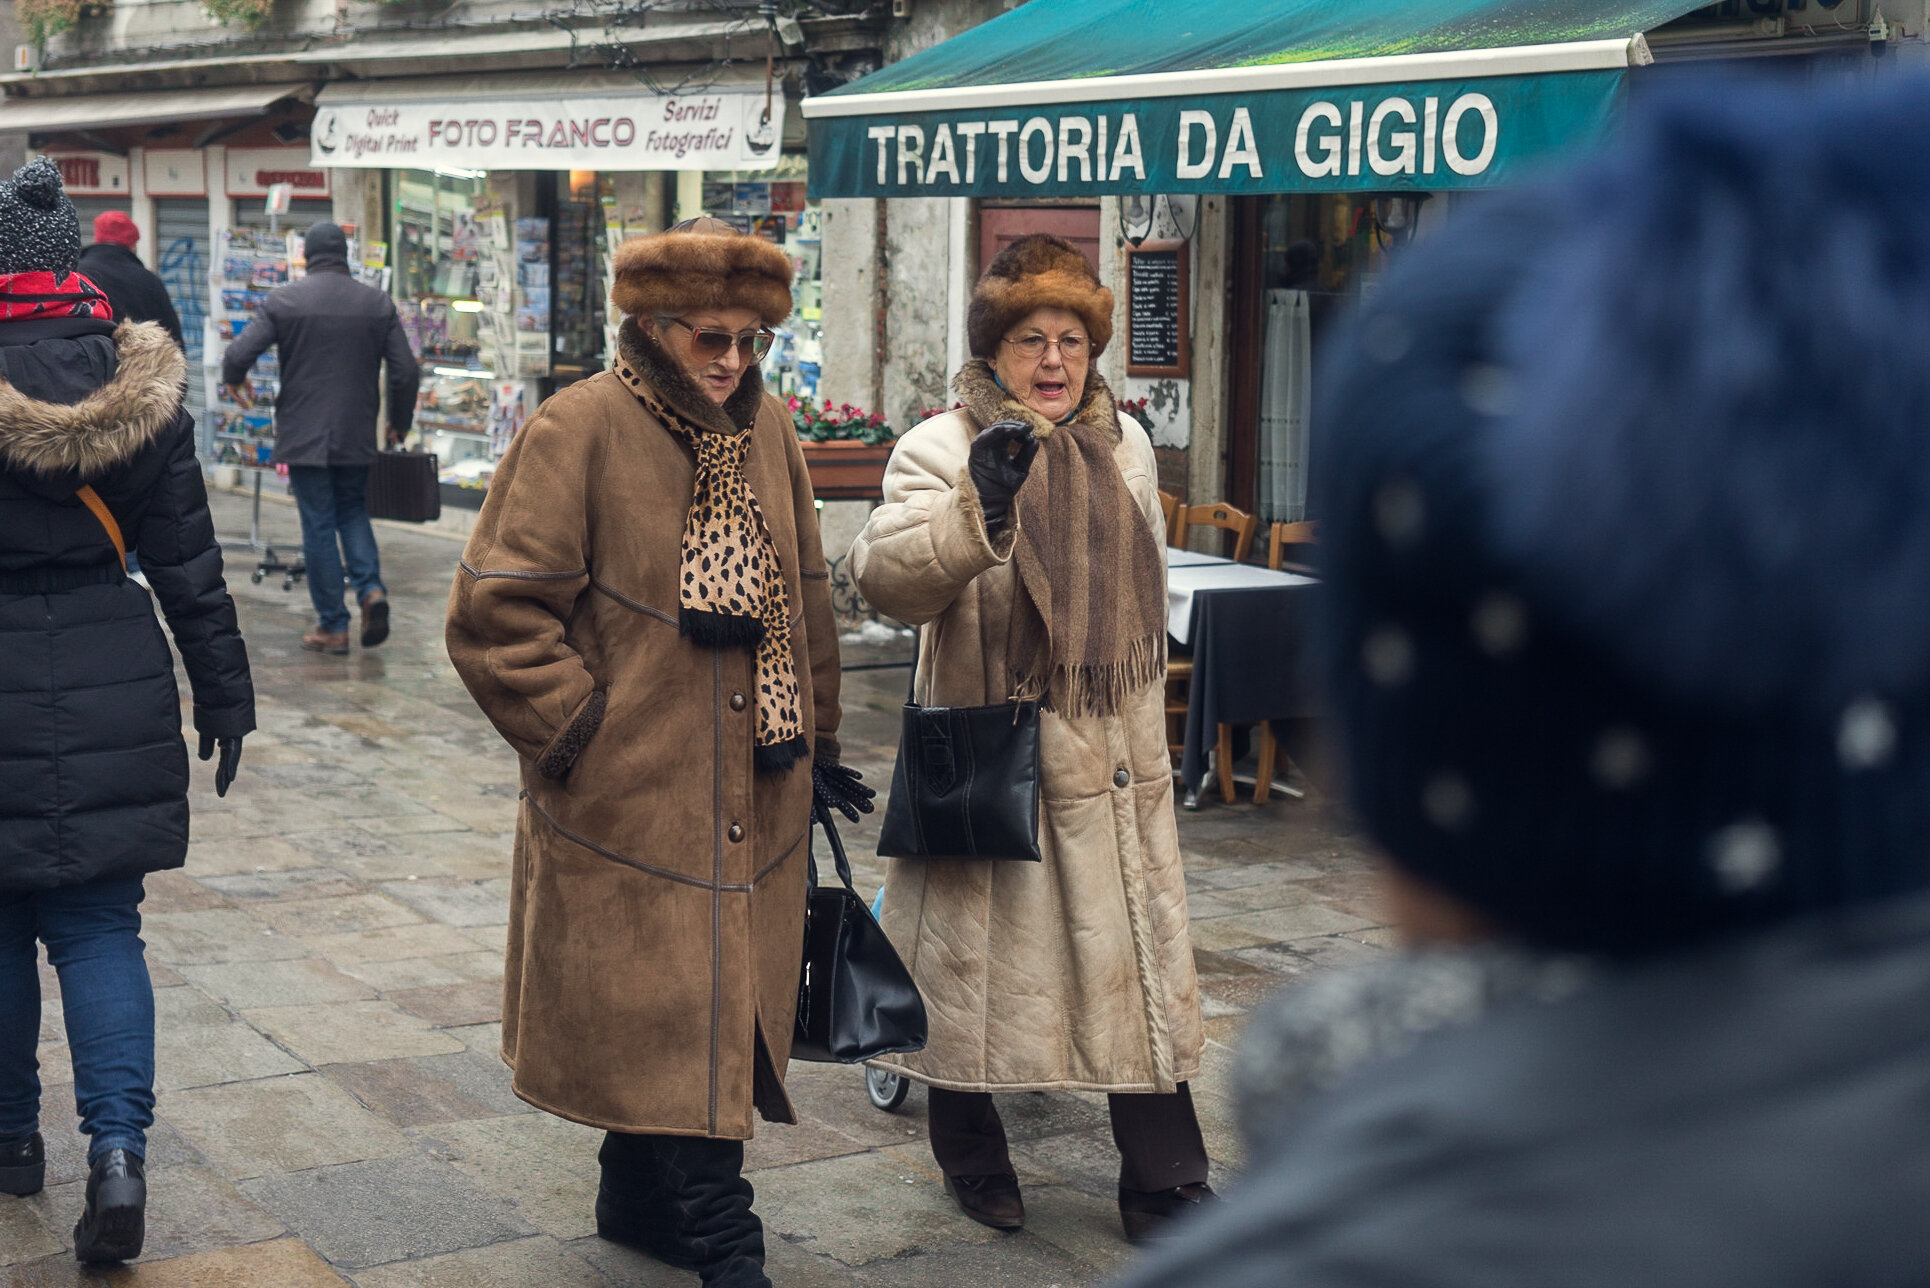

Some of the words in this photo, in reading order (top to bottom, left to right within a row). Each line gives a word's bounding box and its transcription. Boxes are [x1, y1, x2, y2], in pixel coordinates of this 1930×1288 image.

[367, 106, 399, 128] Quick
[663, 97, 722, 123] Servizi
[345, 134, 383, 159] Digital
[385, 135, 419, 152] Print
[428, 119, 497, 148] FOTO
[504, 117, 636, 148] FRANCO
[644, 127, 734, 159] Fotografici
[867, 113, 1146, 186] TRATTORIA
[1176, 106, 1264, 180] DA
[1294, 92, 1498, 178] GIGIO
